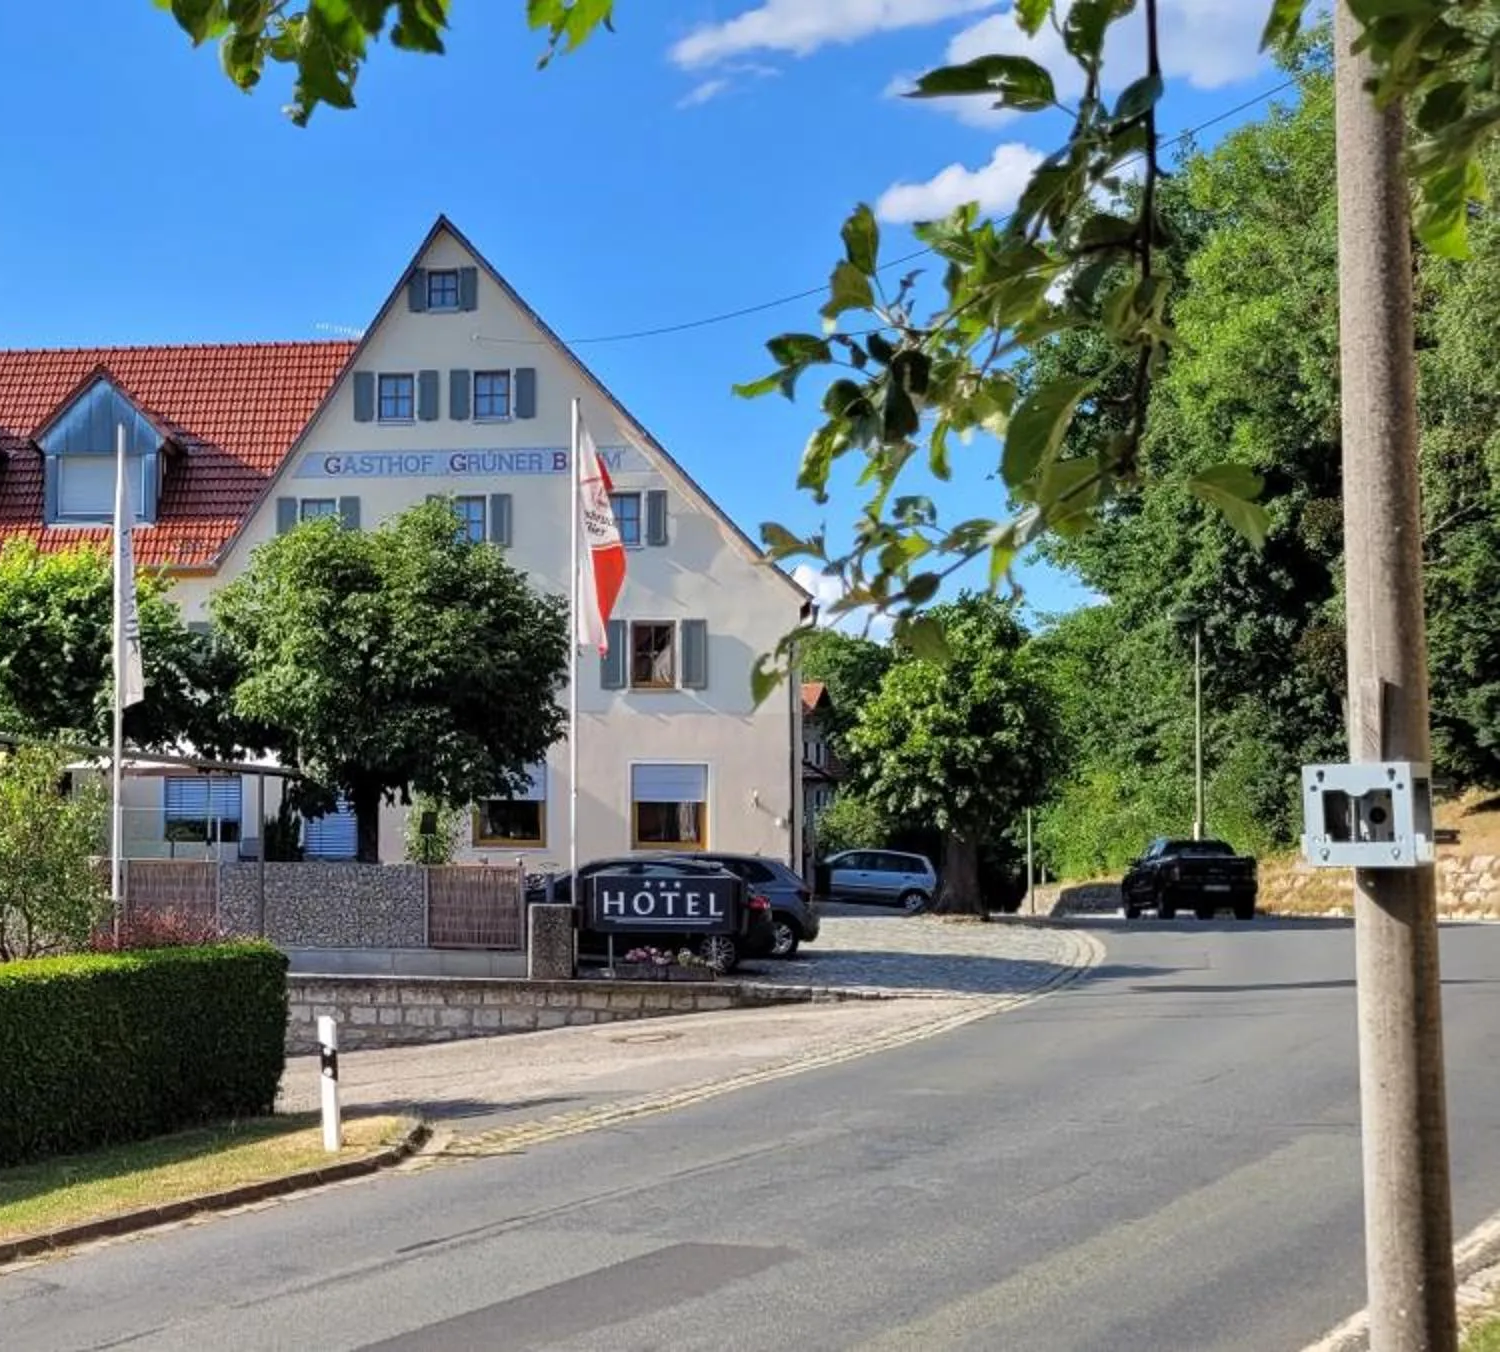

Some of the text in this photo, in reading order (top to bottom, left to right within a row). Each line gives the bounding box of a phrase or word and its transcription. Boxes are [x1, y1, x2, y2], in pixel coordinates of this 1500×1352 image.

[323, 449, 622, 475] GASTHOF GRÜNER BM
[602, 891, 724, 916] HOTEL
